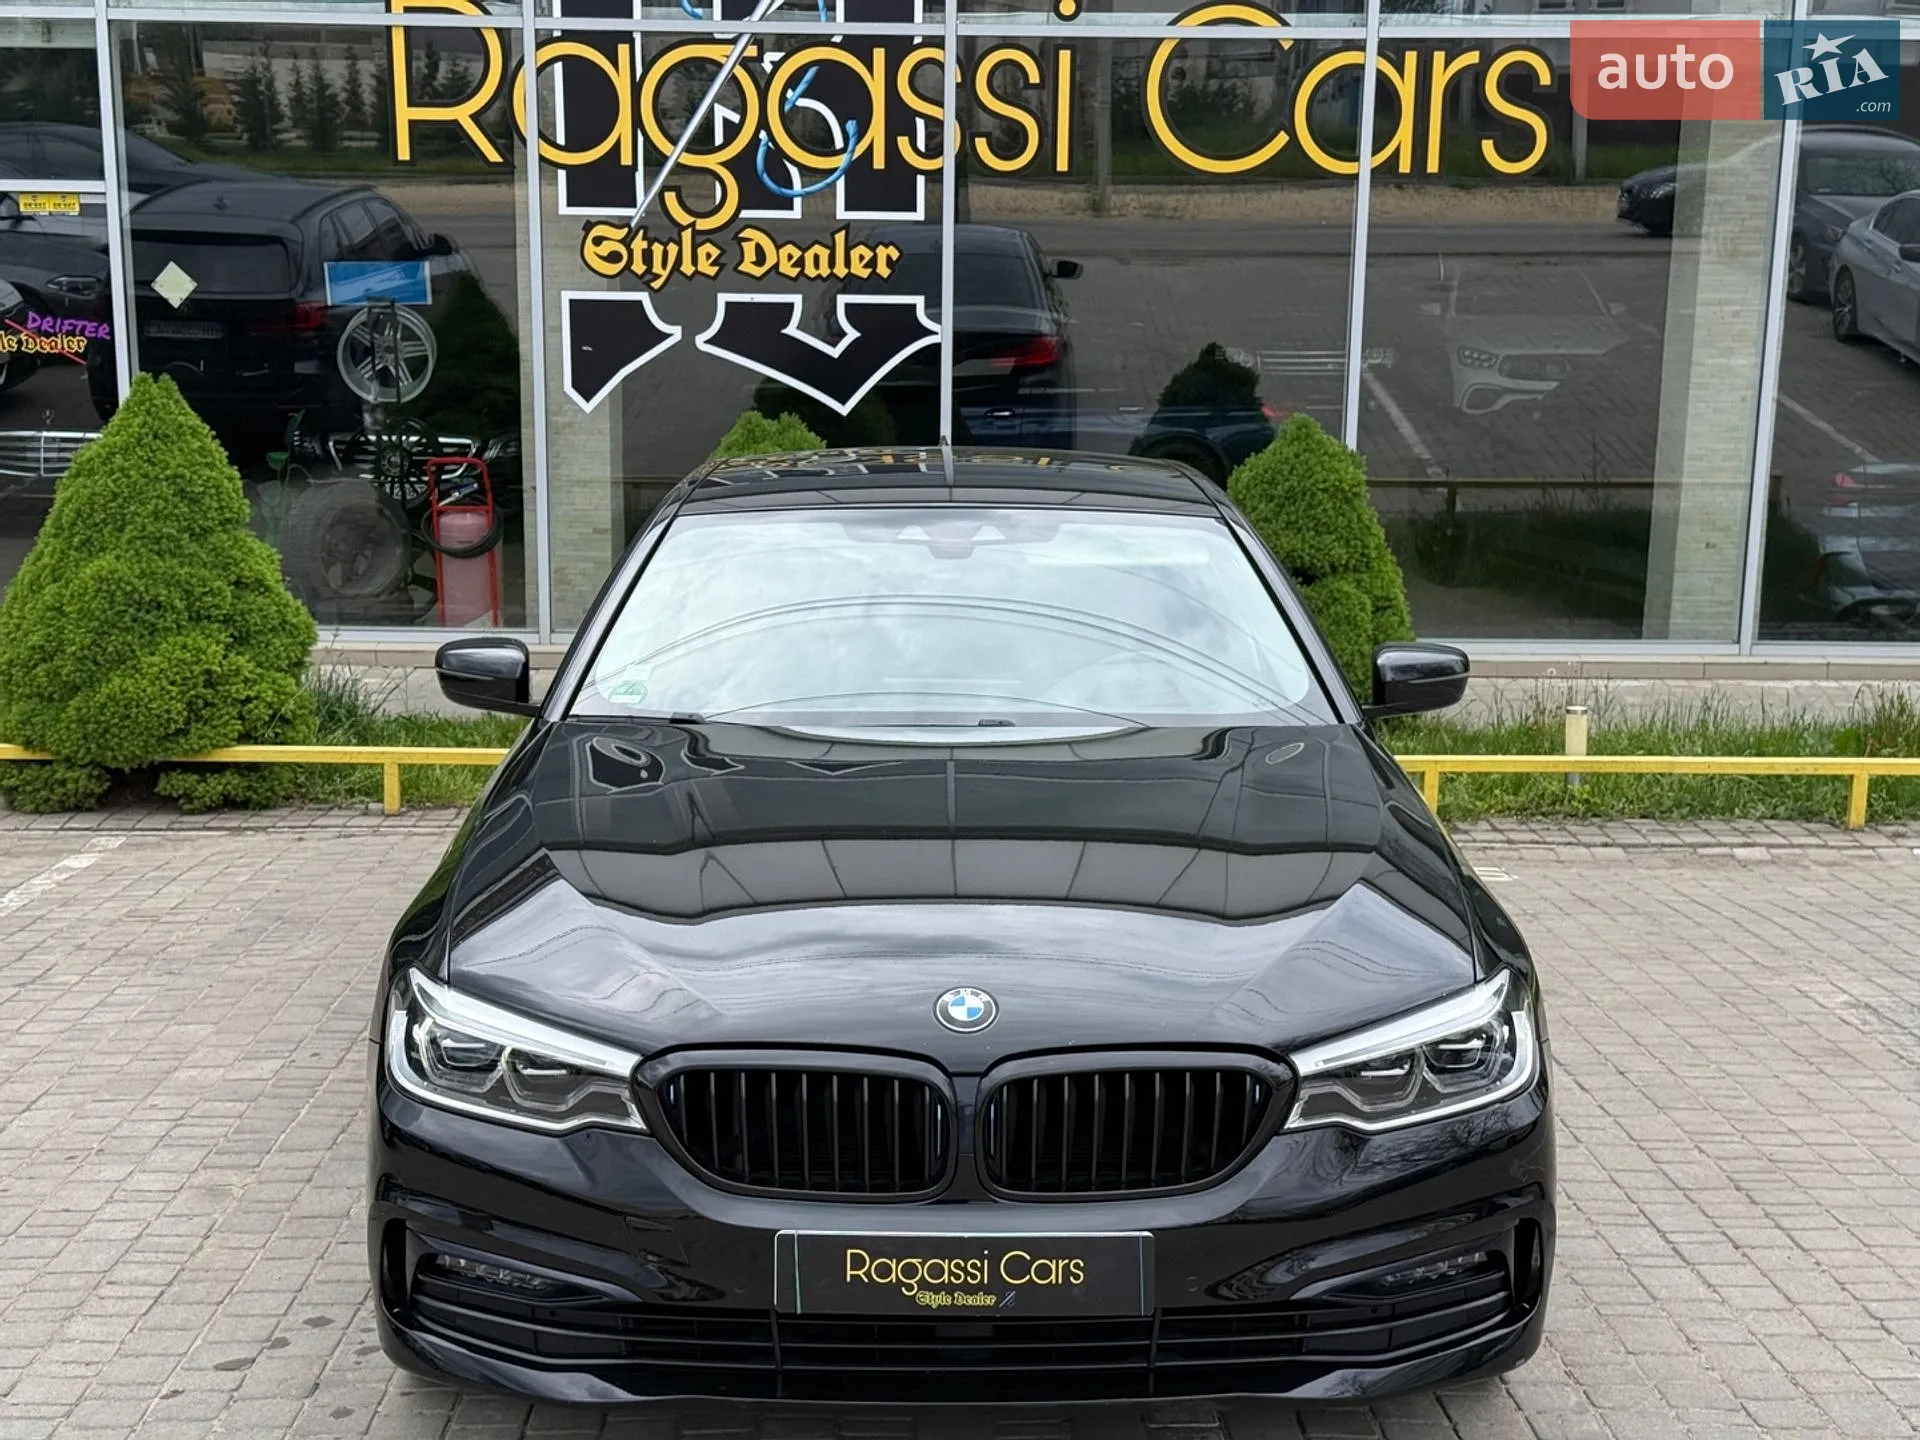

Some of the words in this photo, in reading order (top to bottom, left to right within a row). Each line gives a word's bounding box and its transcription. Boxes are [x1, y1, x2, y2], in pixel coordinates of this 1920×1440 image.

[389, 0, 1077, 231] Ragassi
[1146, 3, 1552, 175] Cars
[582, 223, 721, 291] Style
[735, 227, 901, 279] Dealer
[20, 331, 87, 353] Dealer
[26, 310, 111, 340] DRIFTER
[846, 1248, 989, 1296] Ragassi
[999, 1249, 1085, 1285] Cars
